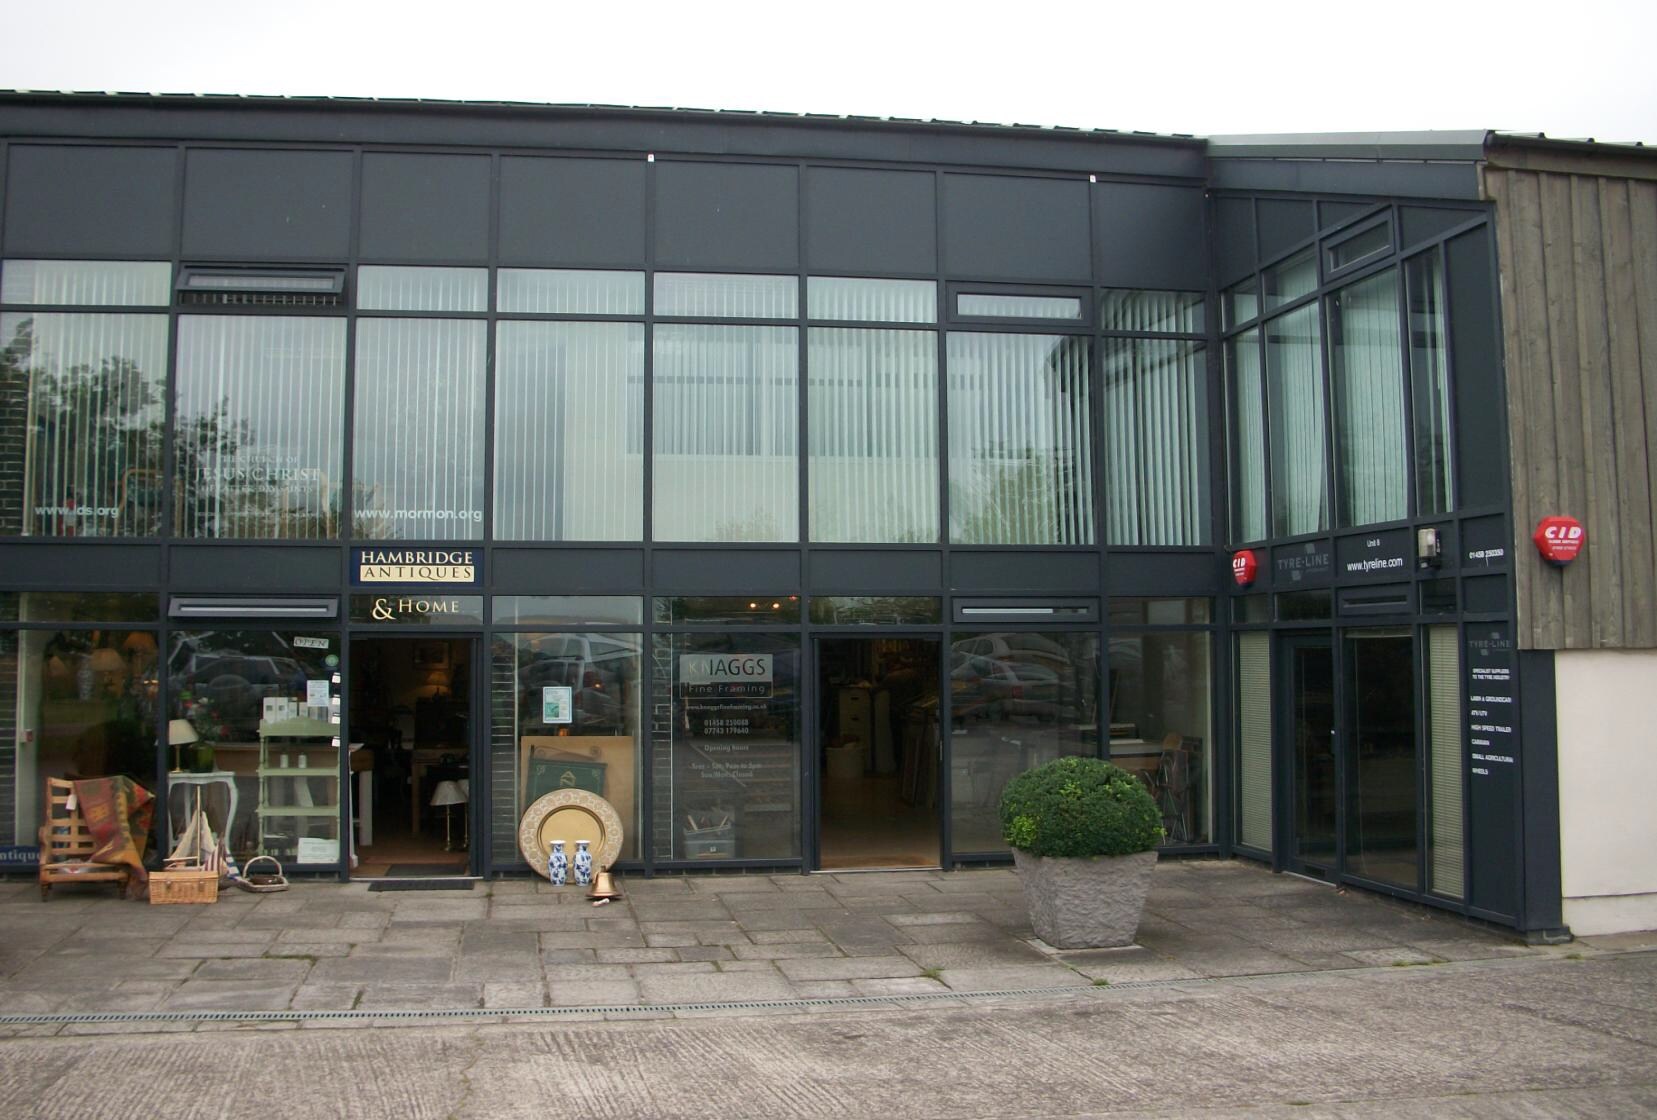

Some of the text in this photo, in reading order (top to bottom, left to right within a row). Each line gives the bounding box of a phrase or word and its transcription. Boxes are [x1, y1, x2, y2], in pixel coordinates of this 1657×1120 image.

[195, 467, 321, 481] JESUS CHRIST
[35, 506, 119, 518] www.lds.org
[354, 508, 482, 521] www.mormon.org
[1545, 526, 1582, 539] CID
[361, 551, 473, 565] HAMBRIDGE
[1232, 557, 1246, 569] CID
[1347, 557, 1403, 572] www.tyreline.com
[364, 566, 471, 580] ANTIQUES
[372, 598, 460, 620] & HOME
[295, 637, 327, 648] OPEN
[689, 658, 766, 676] KNAGGS
[689, 684, 765, 694] Fine Framing
[704, 744, 731, 753] Opening
